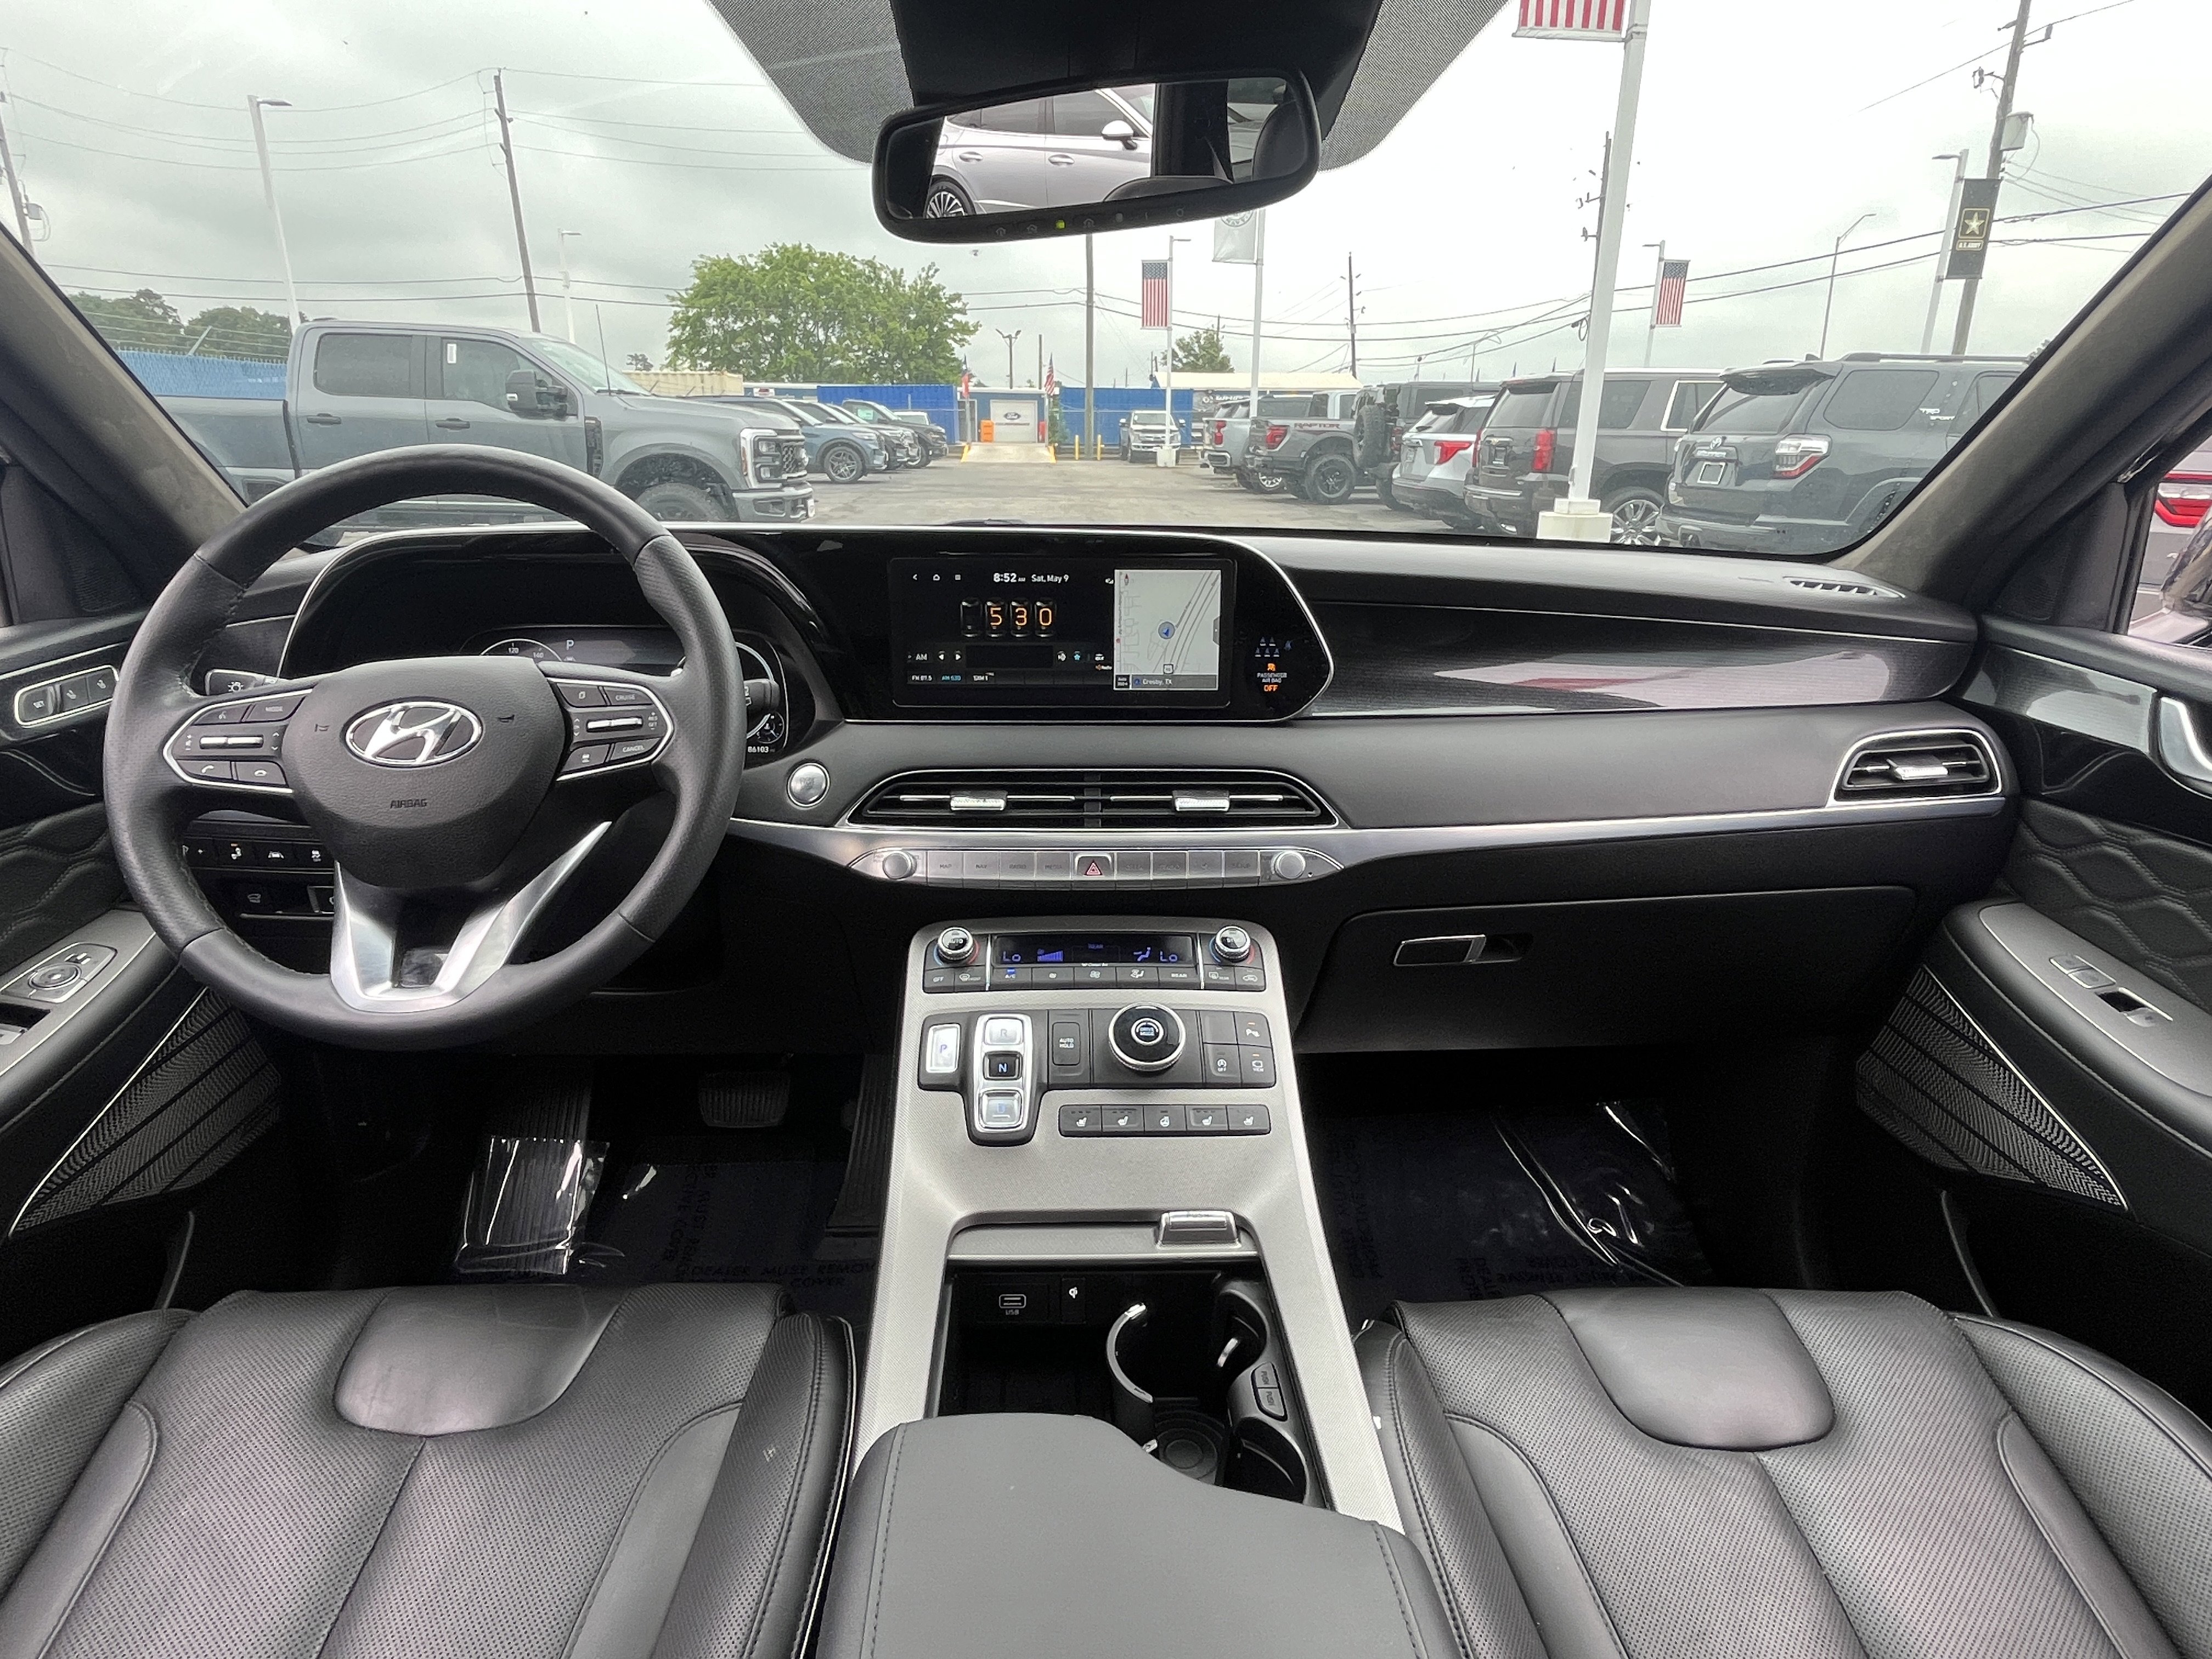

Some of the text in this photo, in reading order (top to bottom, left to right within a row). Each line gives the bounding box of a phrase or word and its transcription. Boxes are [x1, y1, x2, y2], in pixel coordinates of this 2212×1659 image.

[994, 573, 1017, 583] 8:52
[1047, 574, 1063, 584] May
[1063, 574, 1069, 583] 9
[566, 640, 574, 650] P
[390, 799, 427, 809] AIRBAG
[1001, 1028, 1008, 1037] R
[940, 1044, 947, 1053] P
[998, 1063, 1007, 1073] N
